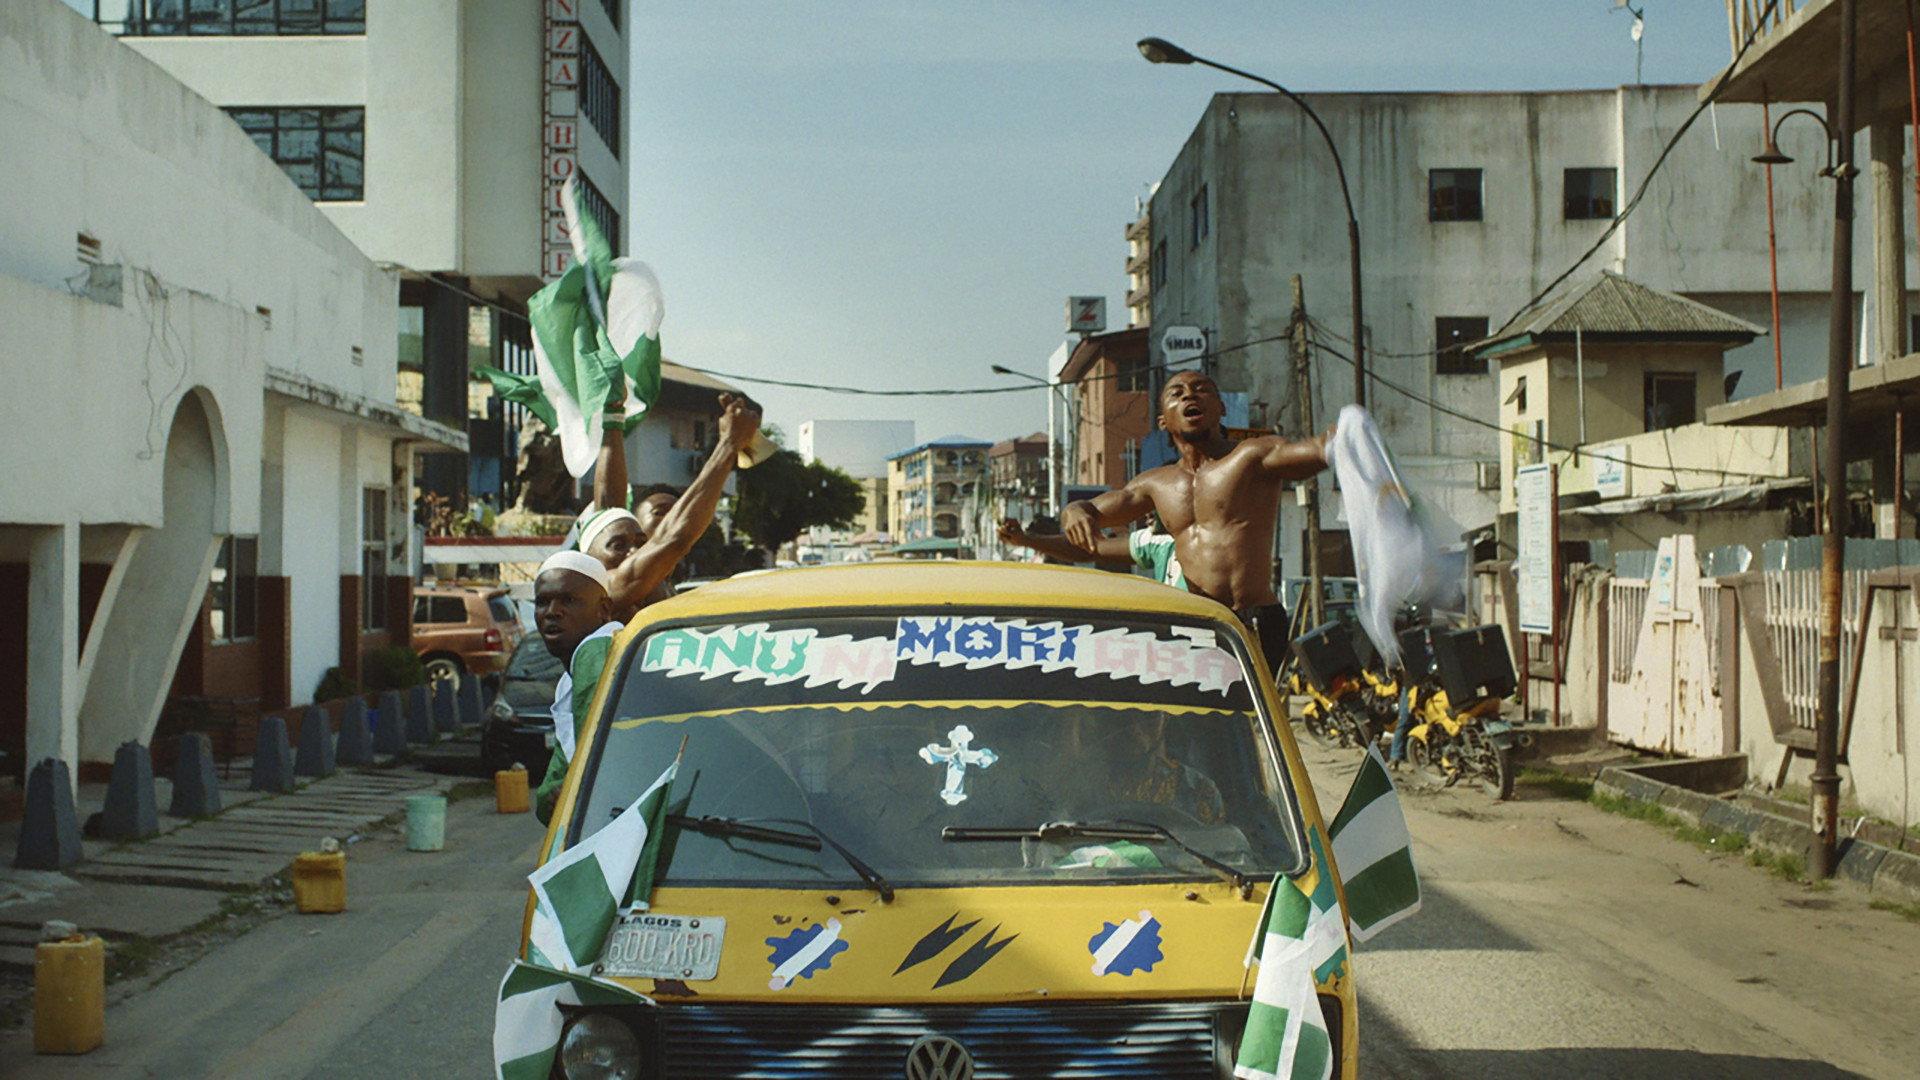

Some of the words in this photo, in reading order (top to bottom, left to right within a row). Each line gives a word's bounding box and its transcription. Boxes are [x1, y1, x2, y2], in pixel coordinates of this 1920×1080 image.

[646, 628, 811, 678] ANU
[897, 617, 1080, 663] MORI
[619, 916, 682, 928] LAGOS
